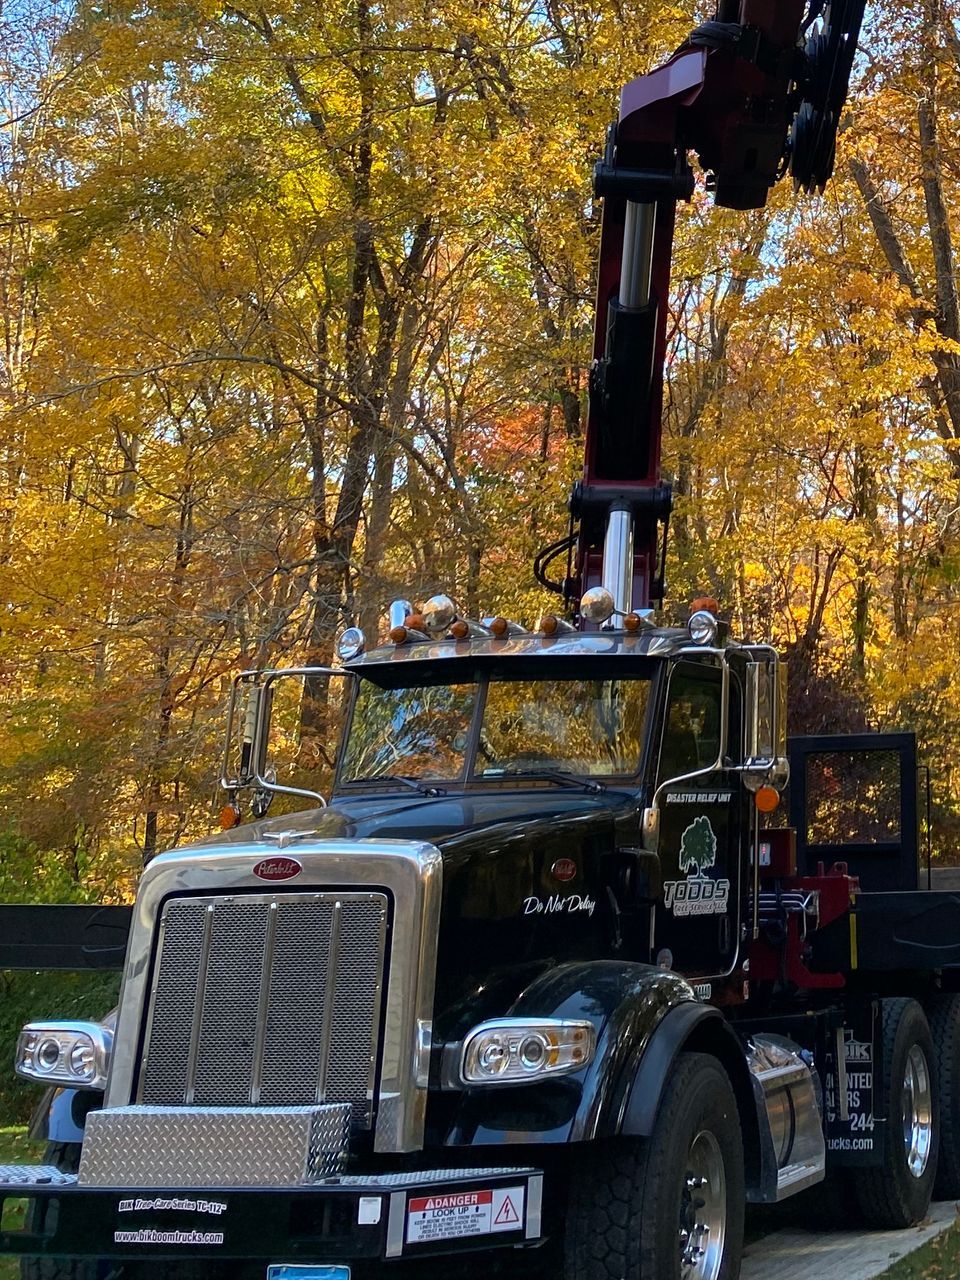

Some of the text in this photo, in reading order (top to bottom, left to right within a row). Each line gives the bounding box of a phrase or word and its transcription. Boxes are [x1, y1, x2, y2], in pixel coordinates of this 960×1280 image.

[666, 793, 697, 803] DISASTER
[697, 793, 718, 803] RELIEF
[523, 893, 596, 918] Do Not Delay
[434, 1194, 478, 1208] DANGER
[432, 1206, 469, 1218] LOOK UP
[114, 1229, 224, 1244] www.bikboomtrucks.com
